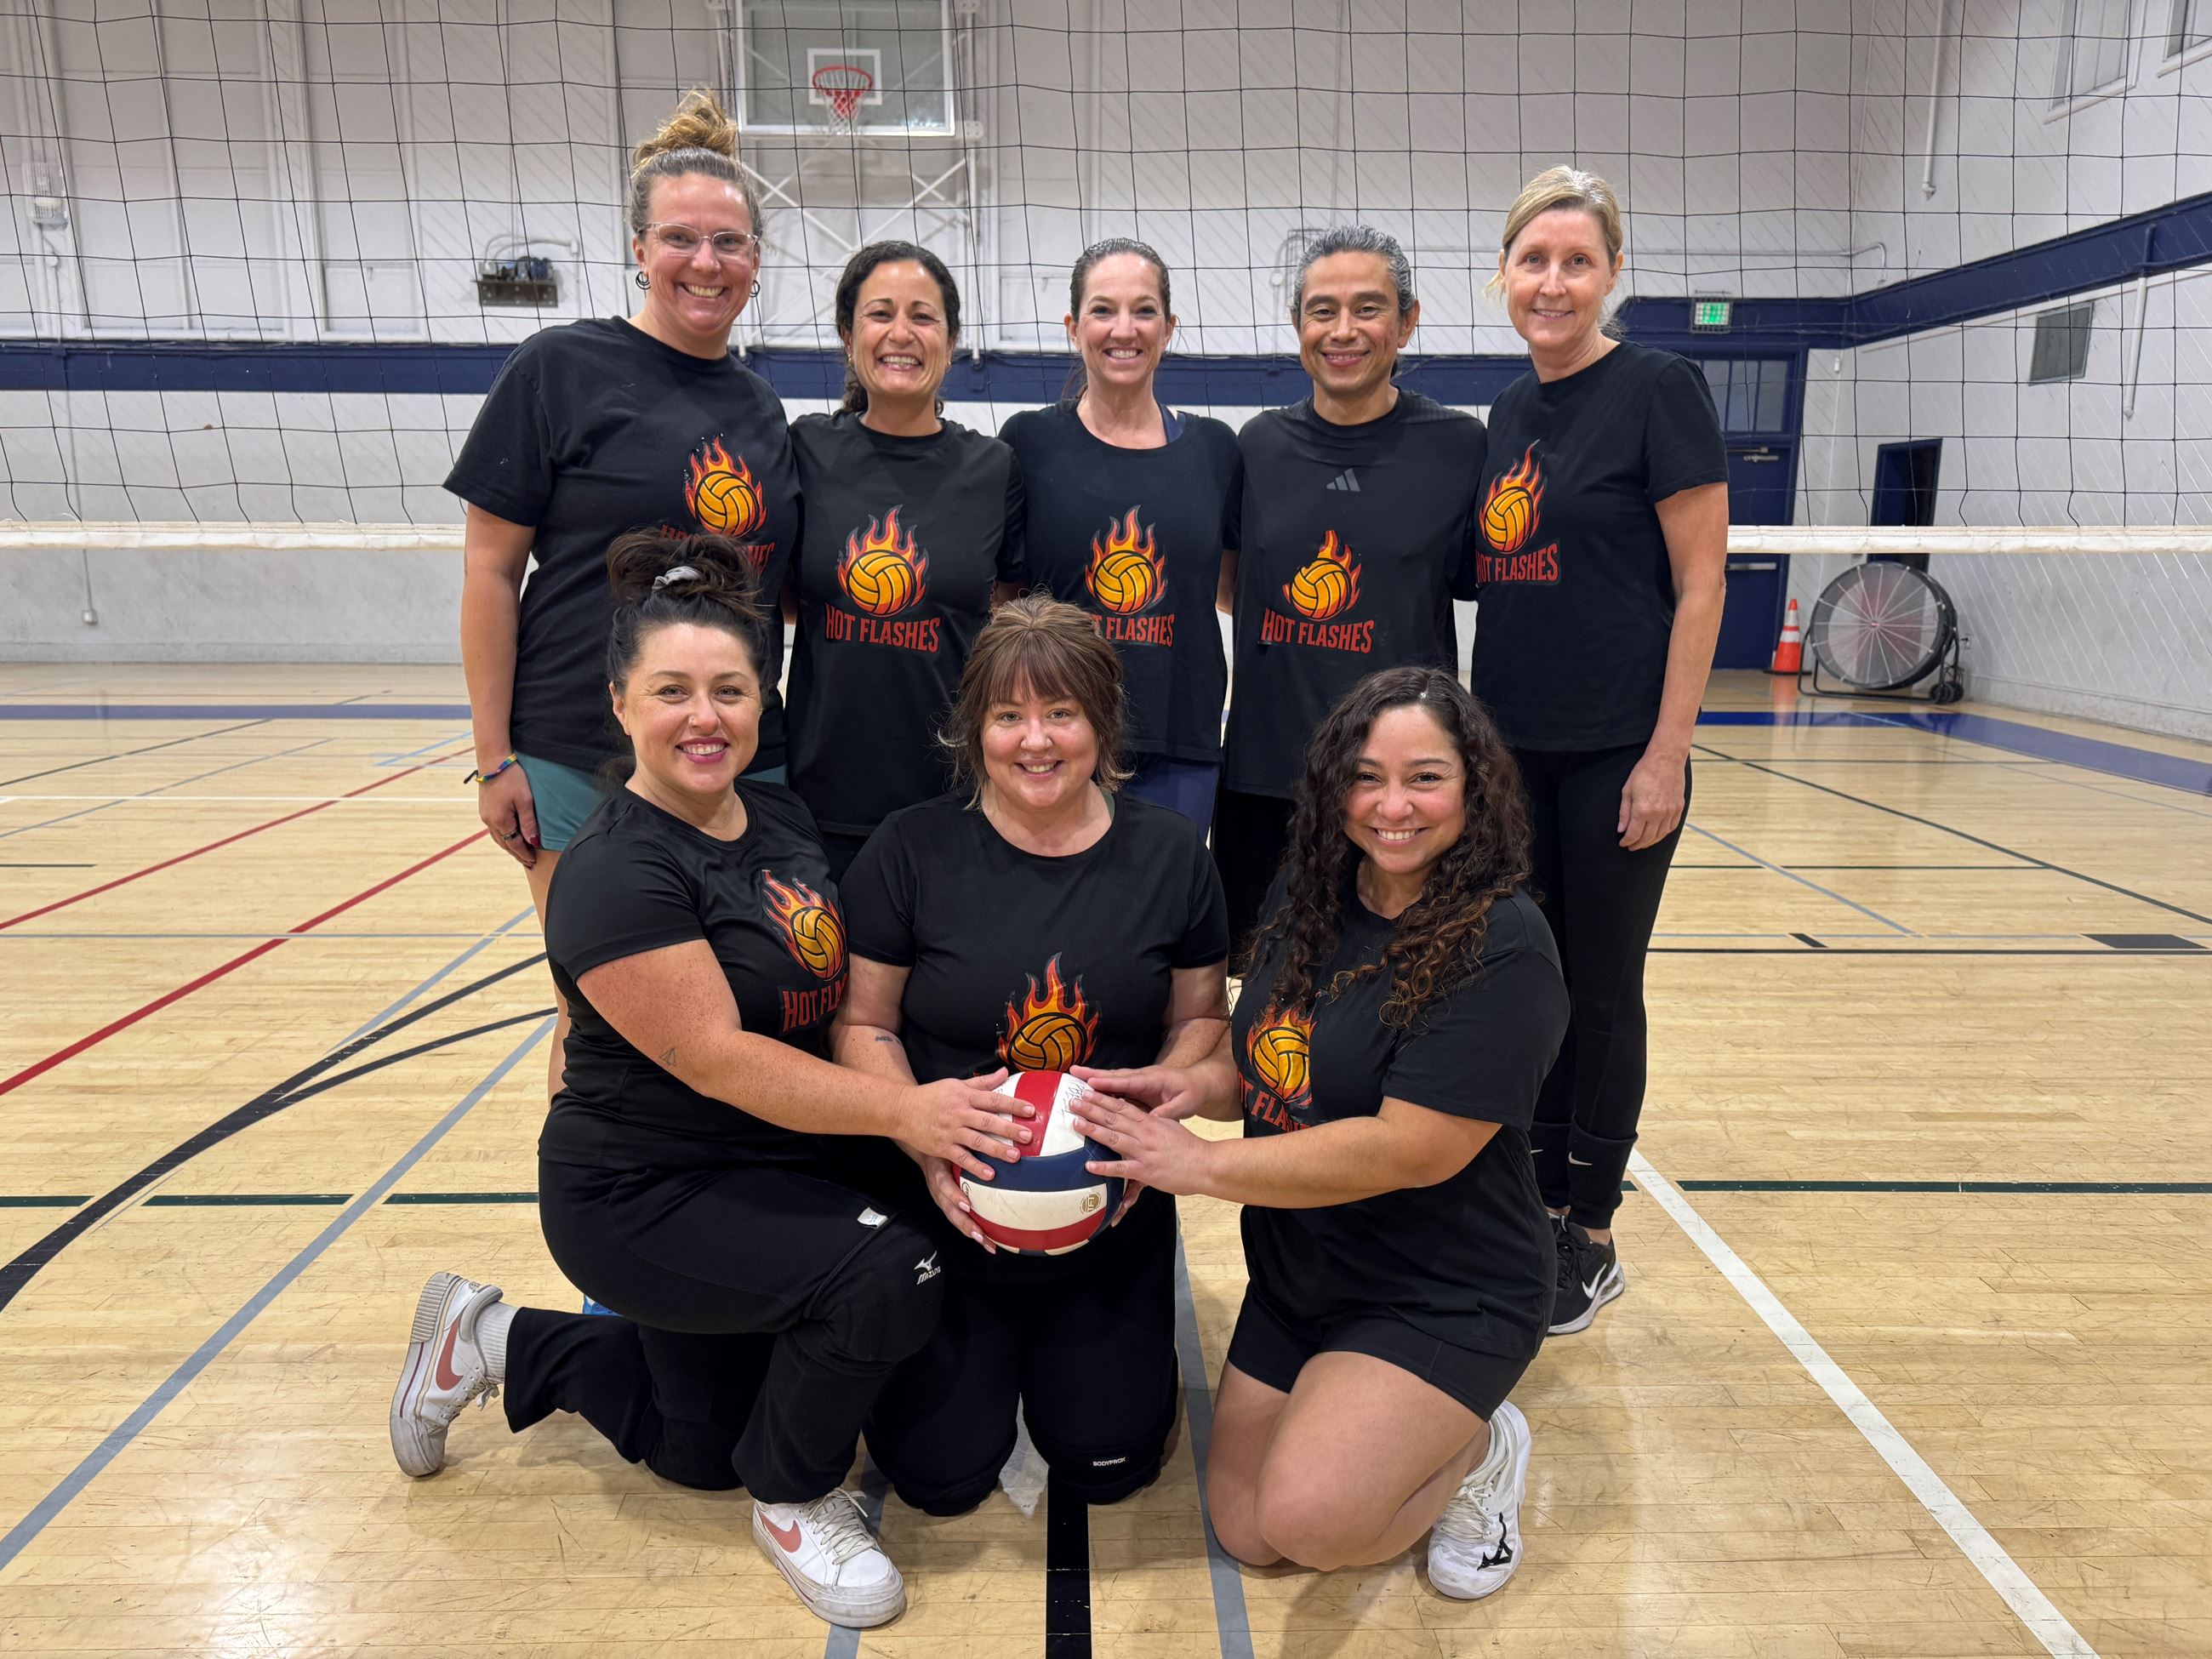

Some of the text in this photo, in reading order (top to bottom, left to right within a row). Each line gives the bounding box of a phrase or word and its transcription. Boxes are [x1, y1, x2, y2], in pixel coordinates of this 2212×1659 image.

[1495, 544, 1559, 581] FLASHES
[824, 602, 940, 653] HOT FLASHES
[1106, 613, 1175, 647] FLASHES
[1261, 607, 1374, 653] HOT FLASHES
[783, 990, 818, 1032] HOT
